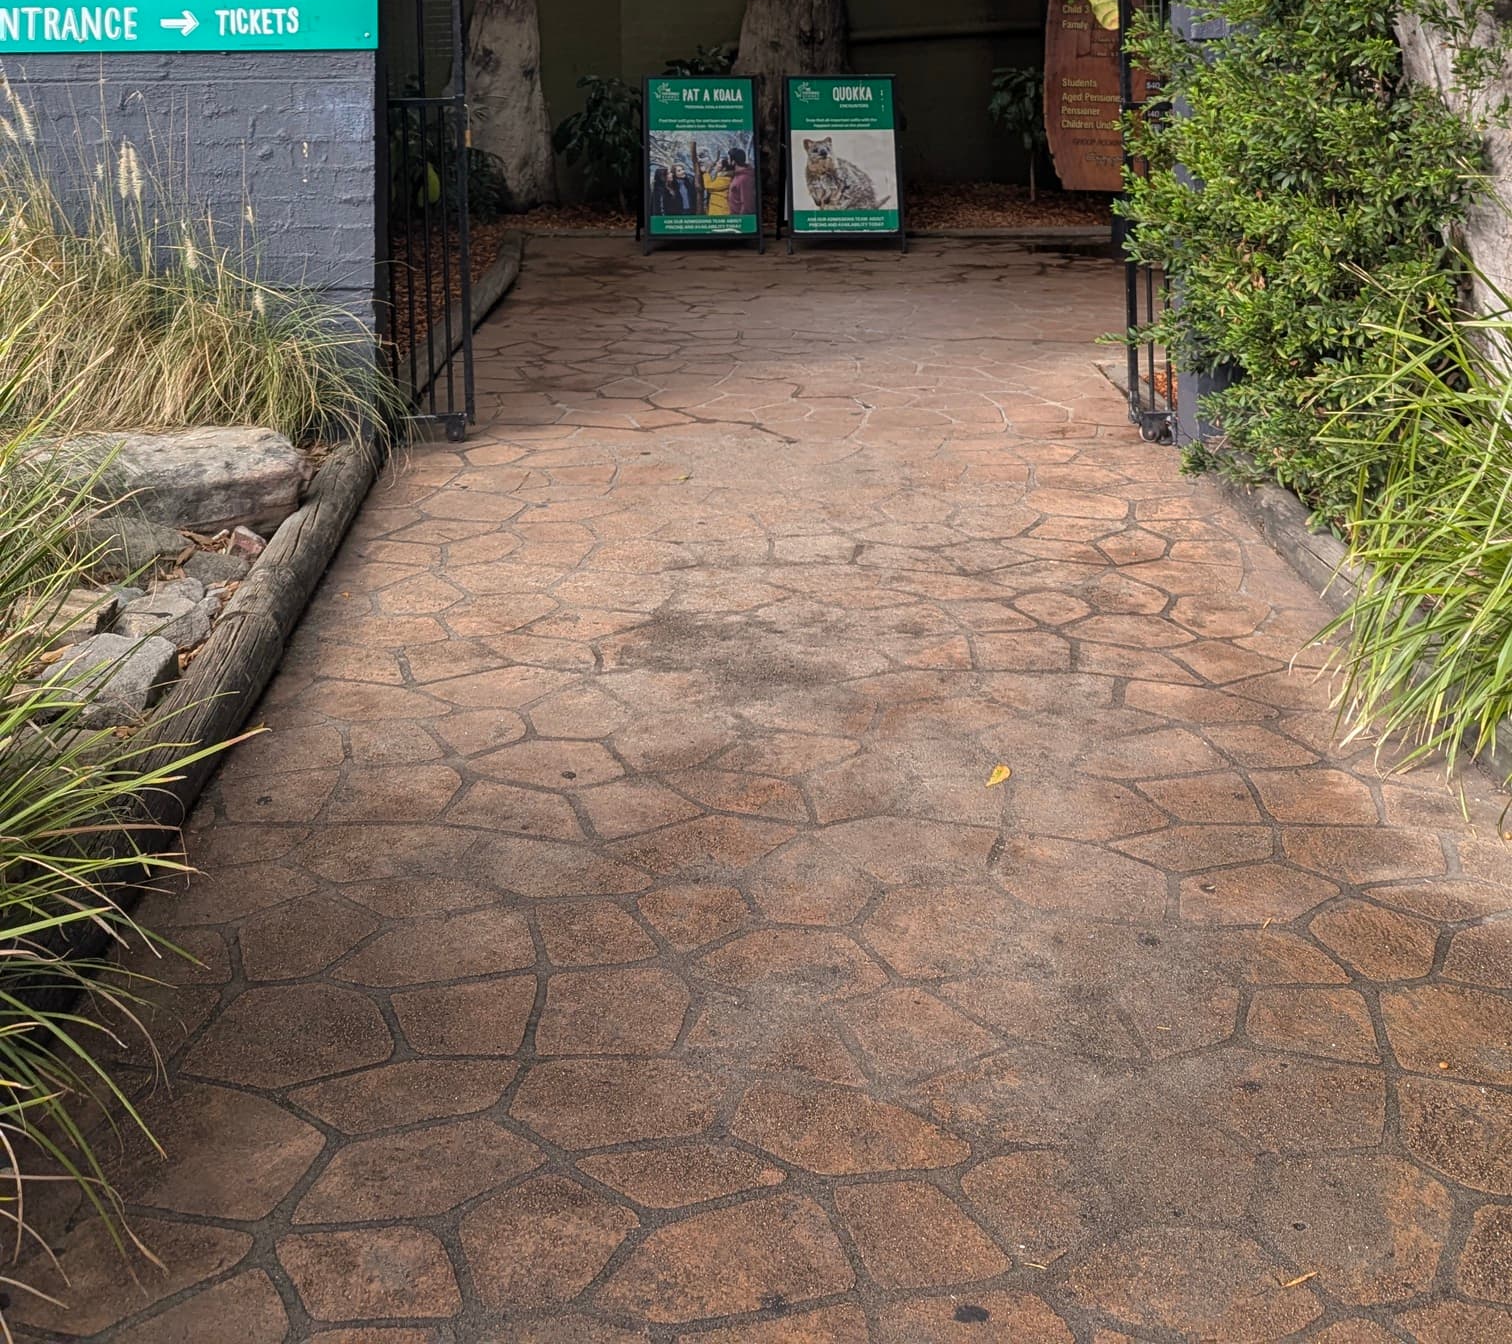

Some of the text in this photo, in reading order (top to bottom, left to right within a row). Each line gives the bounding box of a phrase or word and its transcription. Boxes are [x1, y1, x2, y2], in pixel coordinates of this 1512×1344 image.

[1062, 4, 1082, 14] Child
[0, 6, 299, 41] NTRANCE TICKETS
[1062, 20, 1089, 31] Family
[1061, 77, 1098, 88] Students
[682, 88, 700, 102] PAT
[703, 89, 710, 102] A
[713, 88, 743, 102] KOALA
[832, 86, 873, 102] QUOKKA
[1061, 93, 1083, 104] Aged
[1061, 105, 1100, 116] Pensioner
[1061, 119, 1094, 129] Children
